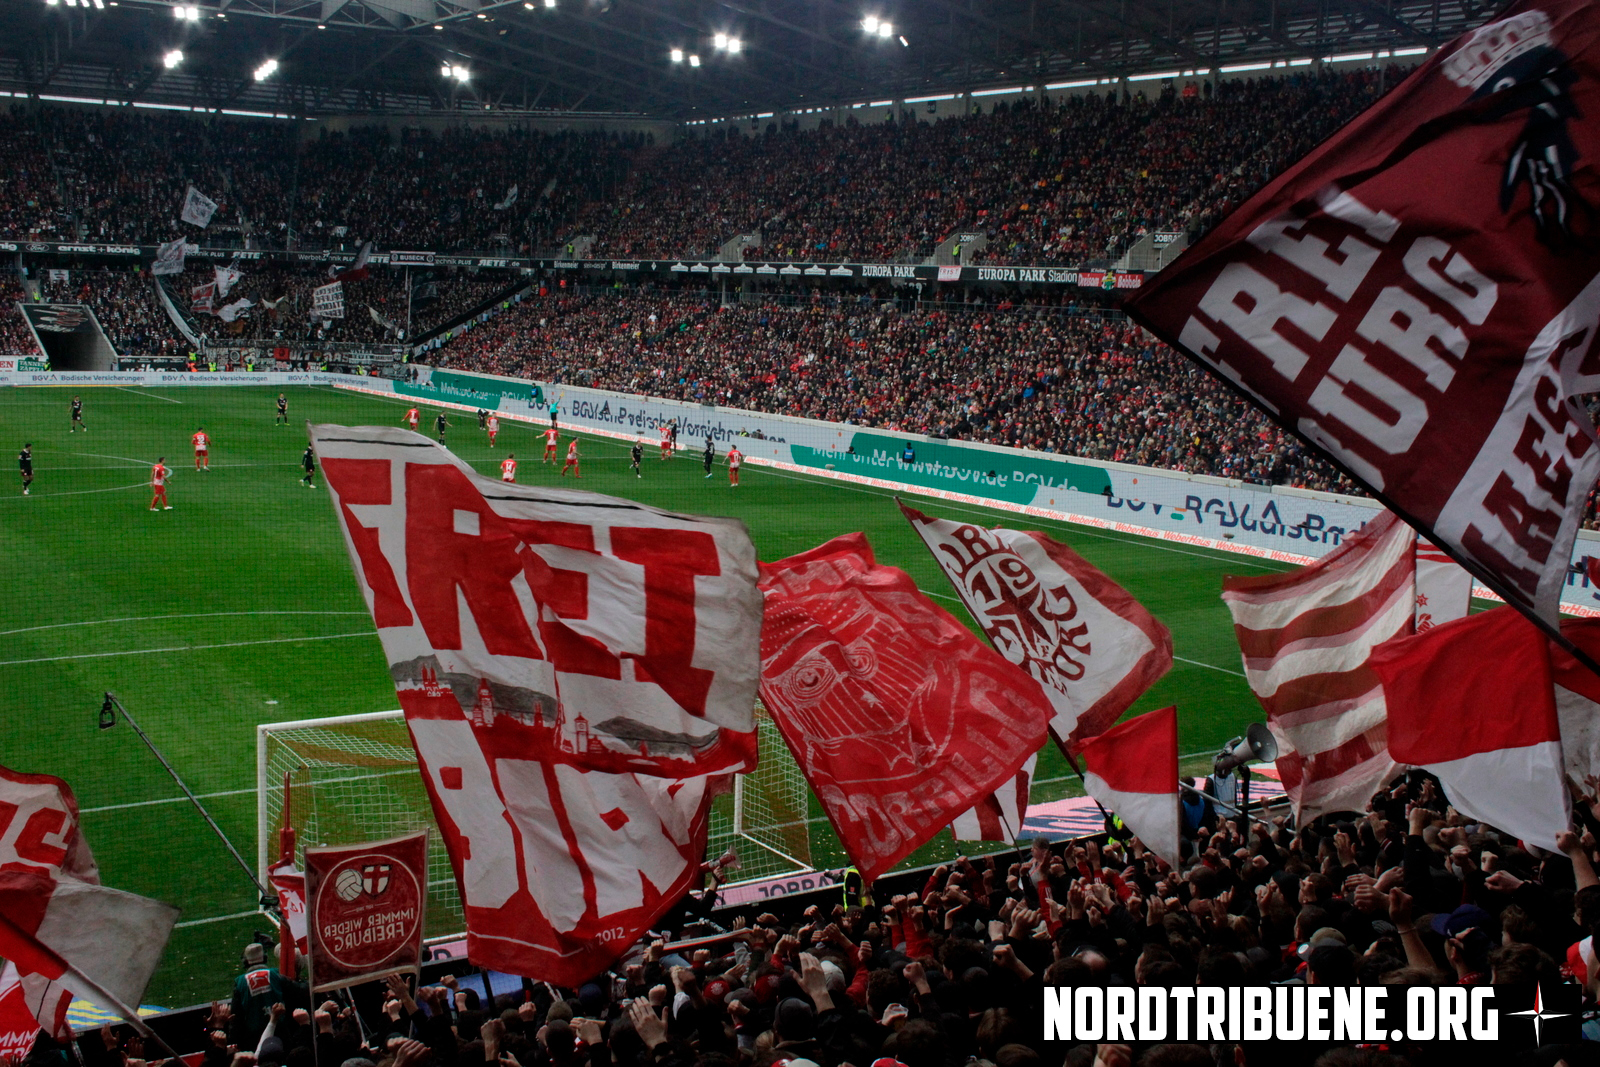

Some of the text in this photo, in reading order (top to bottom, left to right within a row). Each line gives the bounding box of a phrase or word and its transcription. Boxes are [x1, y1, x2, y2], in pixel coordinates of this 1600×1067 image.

[400, 254, 425, 262] BUSECK
[862, 265, 892, 277] EUROPA
[894, 267, 916, 277] PARK
[978, 268, 1078, 284] EUROPA PARK Stadion
[1077, 272, 1100, 287] Dreisam
[32, 373, 145, 383] BGV Badische Versicherungen
[162, 374, 268, 383] BGV Badische Versicherungen
[287, 374, 304, 382] BGV
[944, 489, 982, 505] WeberHaus
[983, 497, 1023, 513] WeberHaus
[1024, 504, 1066, 521] WeberHaus
[1114, 522, 1160, 539] WeberHaus
[1163, 530, 1212, 548] WeberHaus
[1215, 540, 1267, 558] WeberHaus
[320, 457, 721, 718] FREI
[595, 926, 626, 945] 2012
